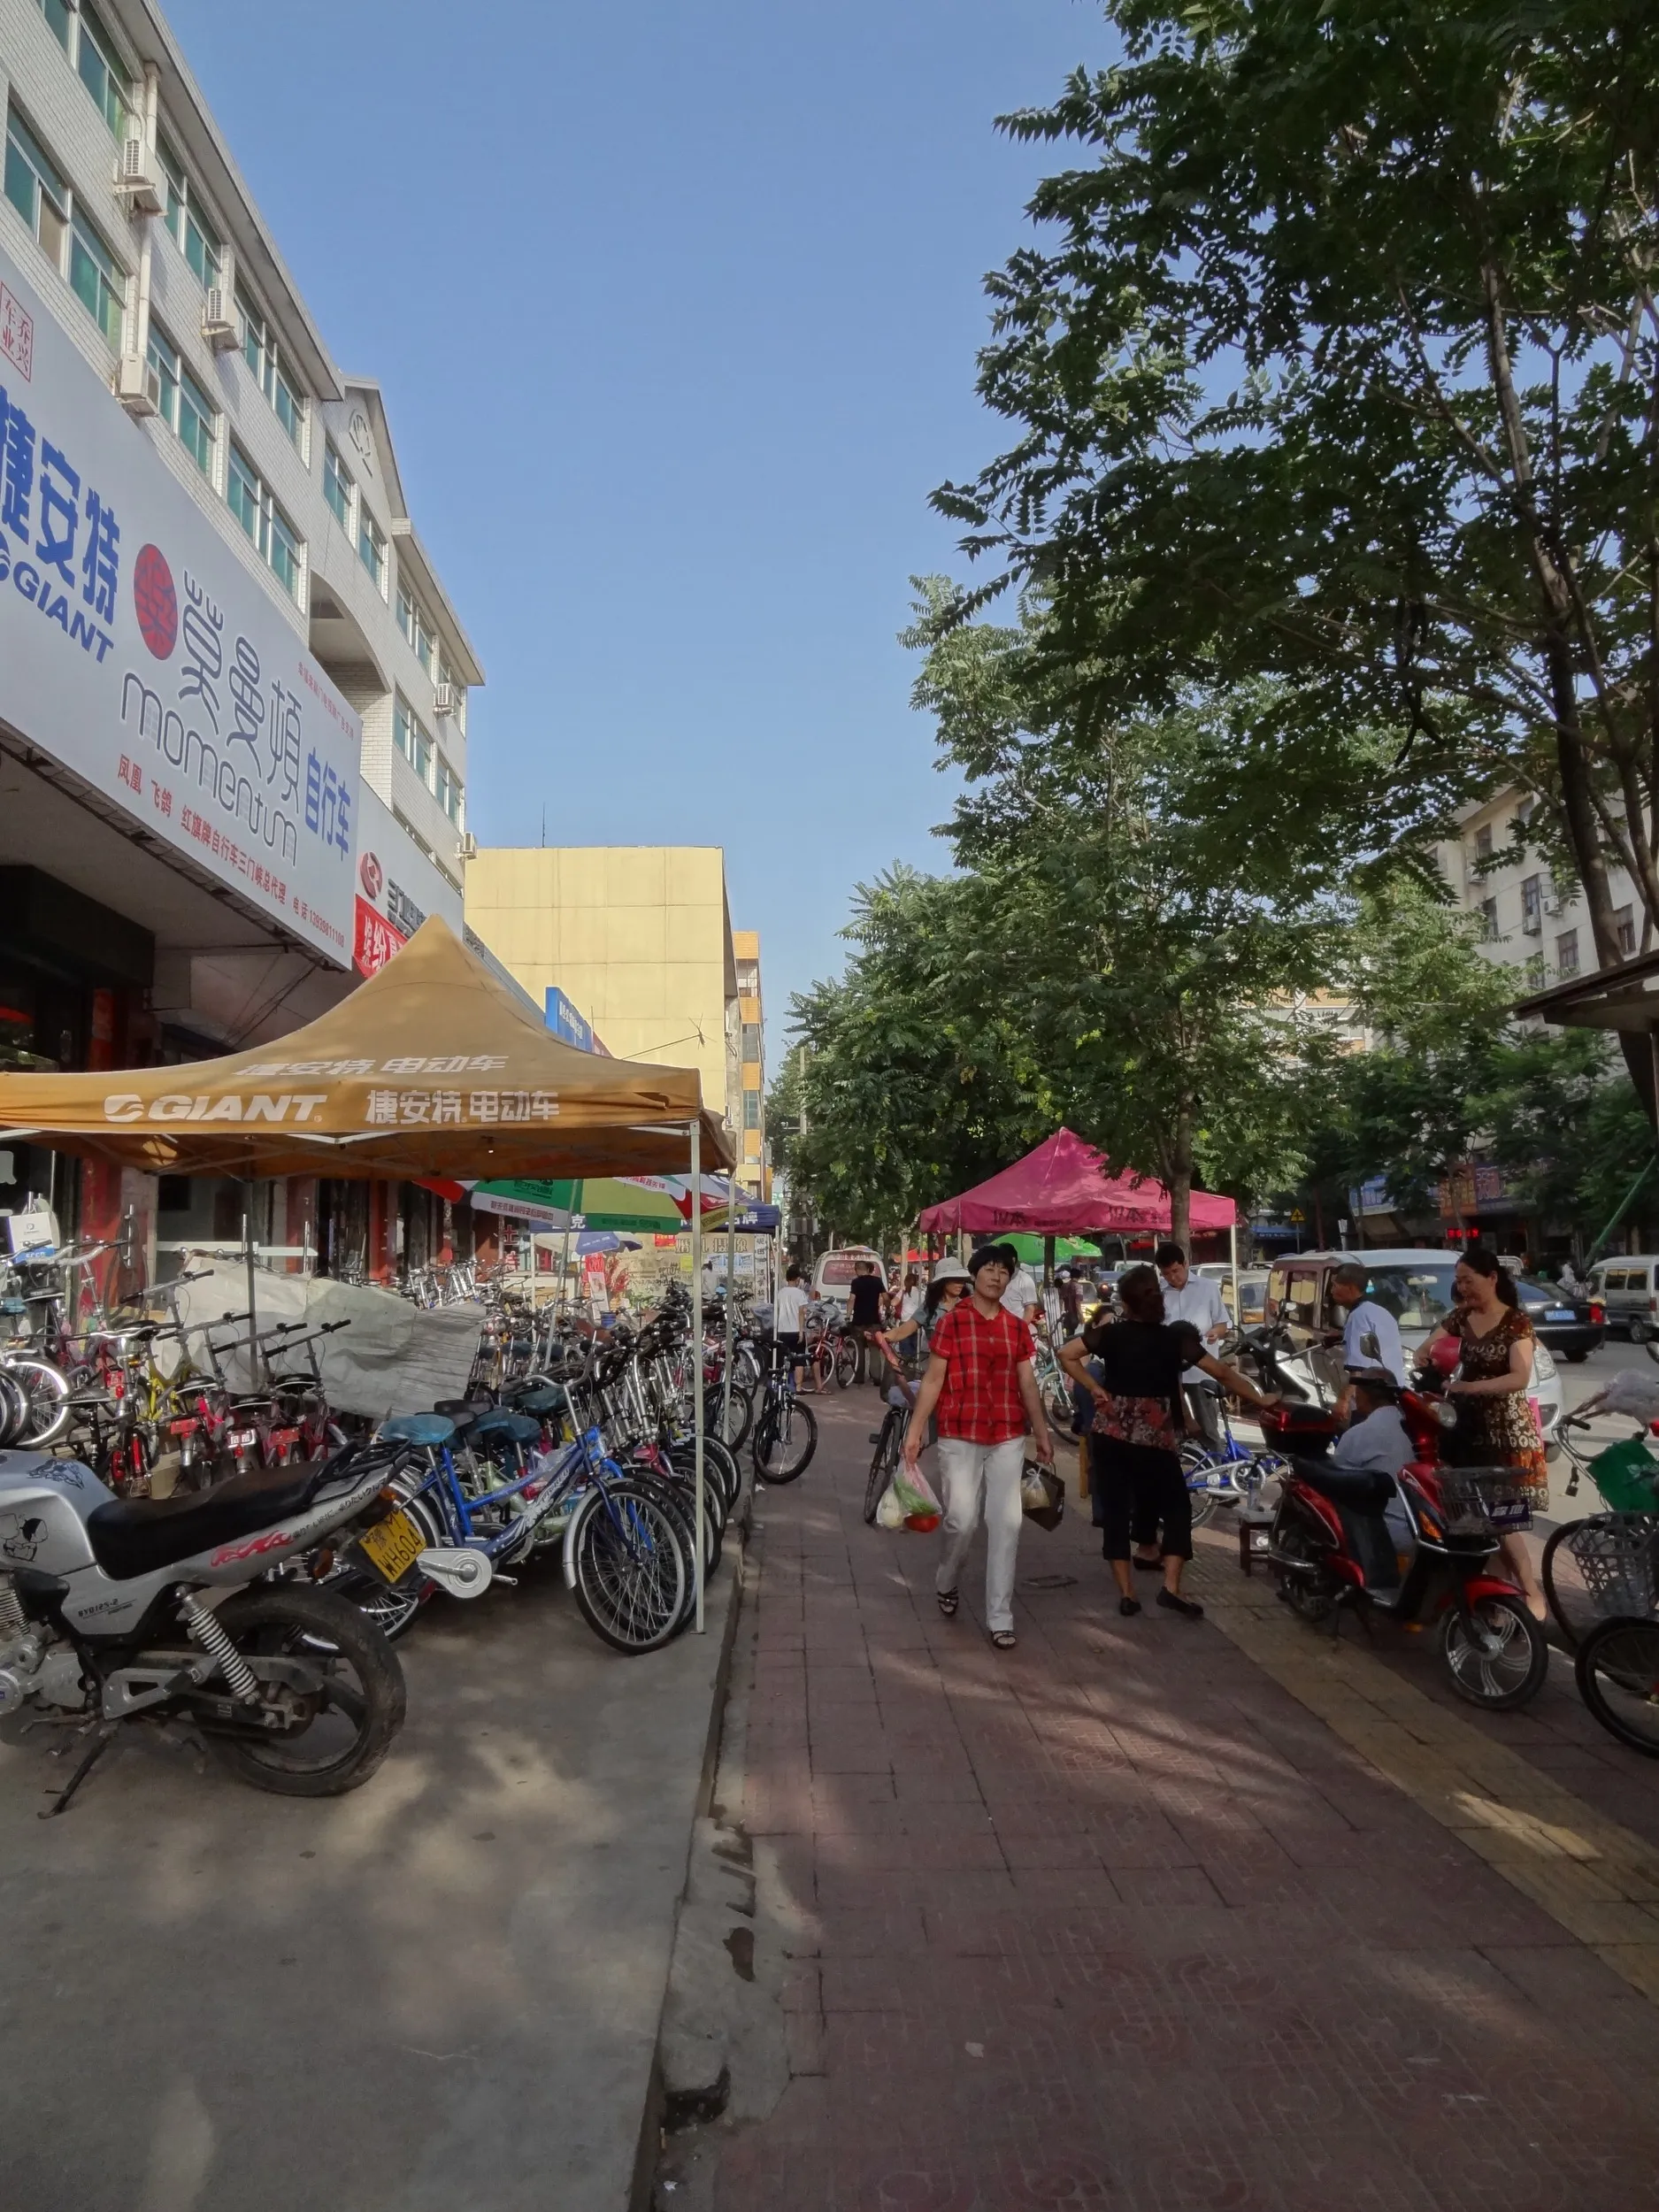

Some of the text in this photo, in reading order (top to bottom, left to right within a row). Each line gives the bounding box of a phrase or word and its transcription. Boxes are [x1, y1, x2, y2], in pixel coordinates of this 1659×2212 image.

[12, 561, 114, 664] GIANT
[118, 753, 142, 795] 凤凰
[151, 779, 173, 818] 飞鸽
[121, 672, 297, 867] momentum
[305, 747, 351, 862] 自行车
[232, 1055, 509, 1076] 捷安特 电动车
[148, 1094, 327, 1122] GIANT
[365, 1089, 560, 1125] 捷安特 电动车
[378, 1527, 423, 1578] WH604
